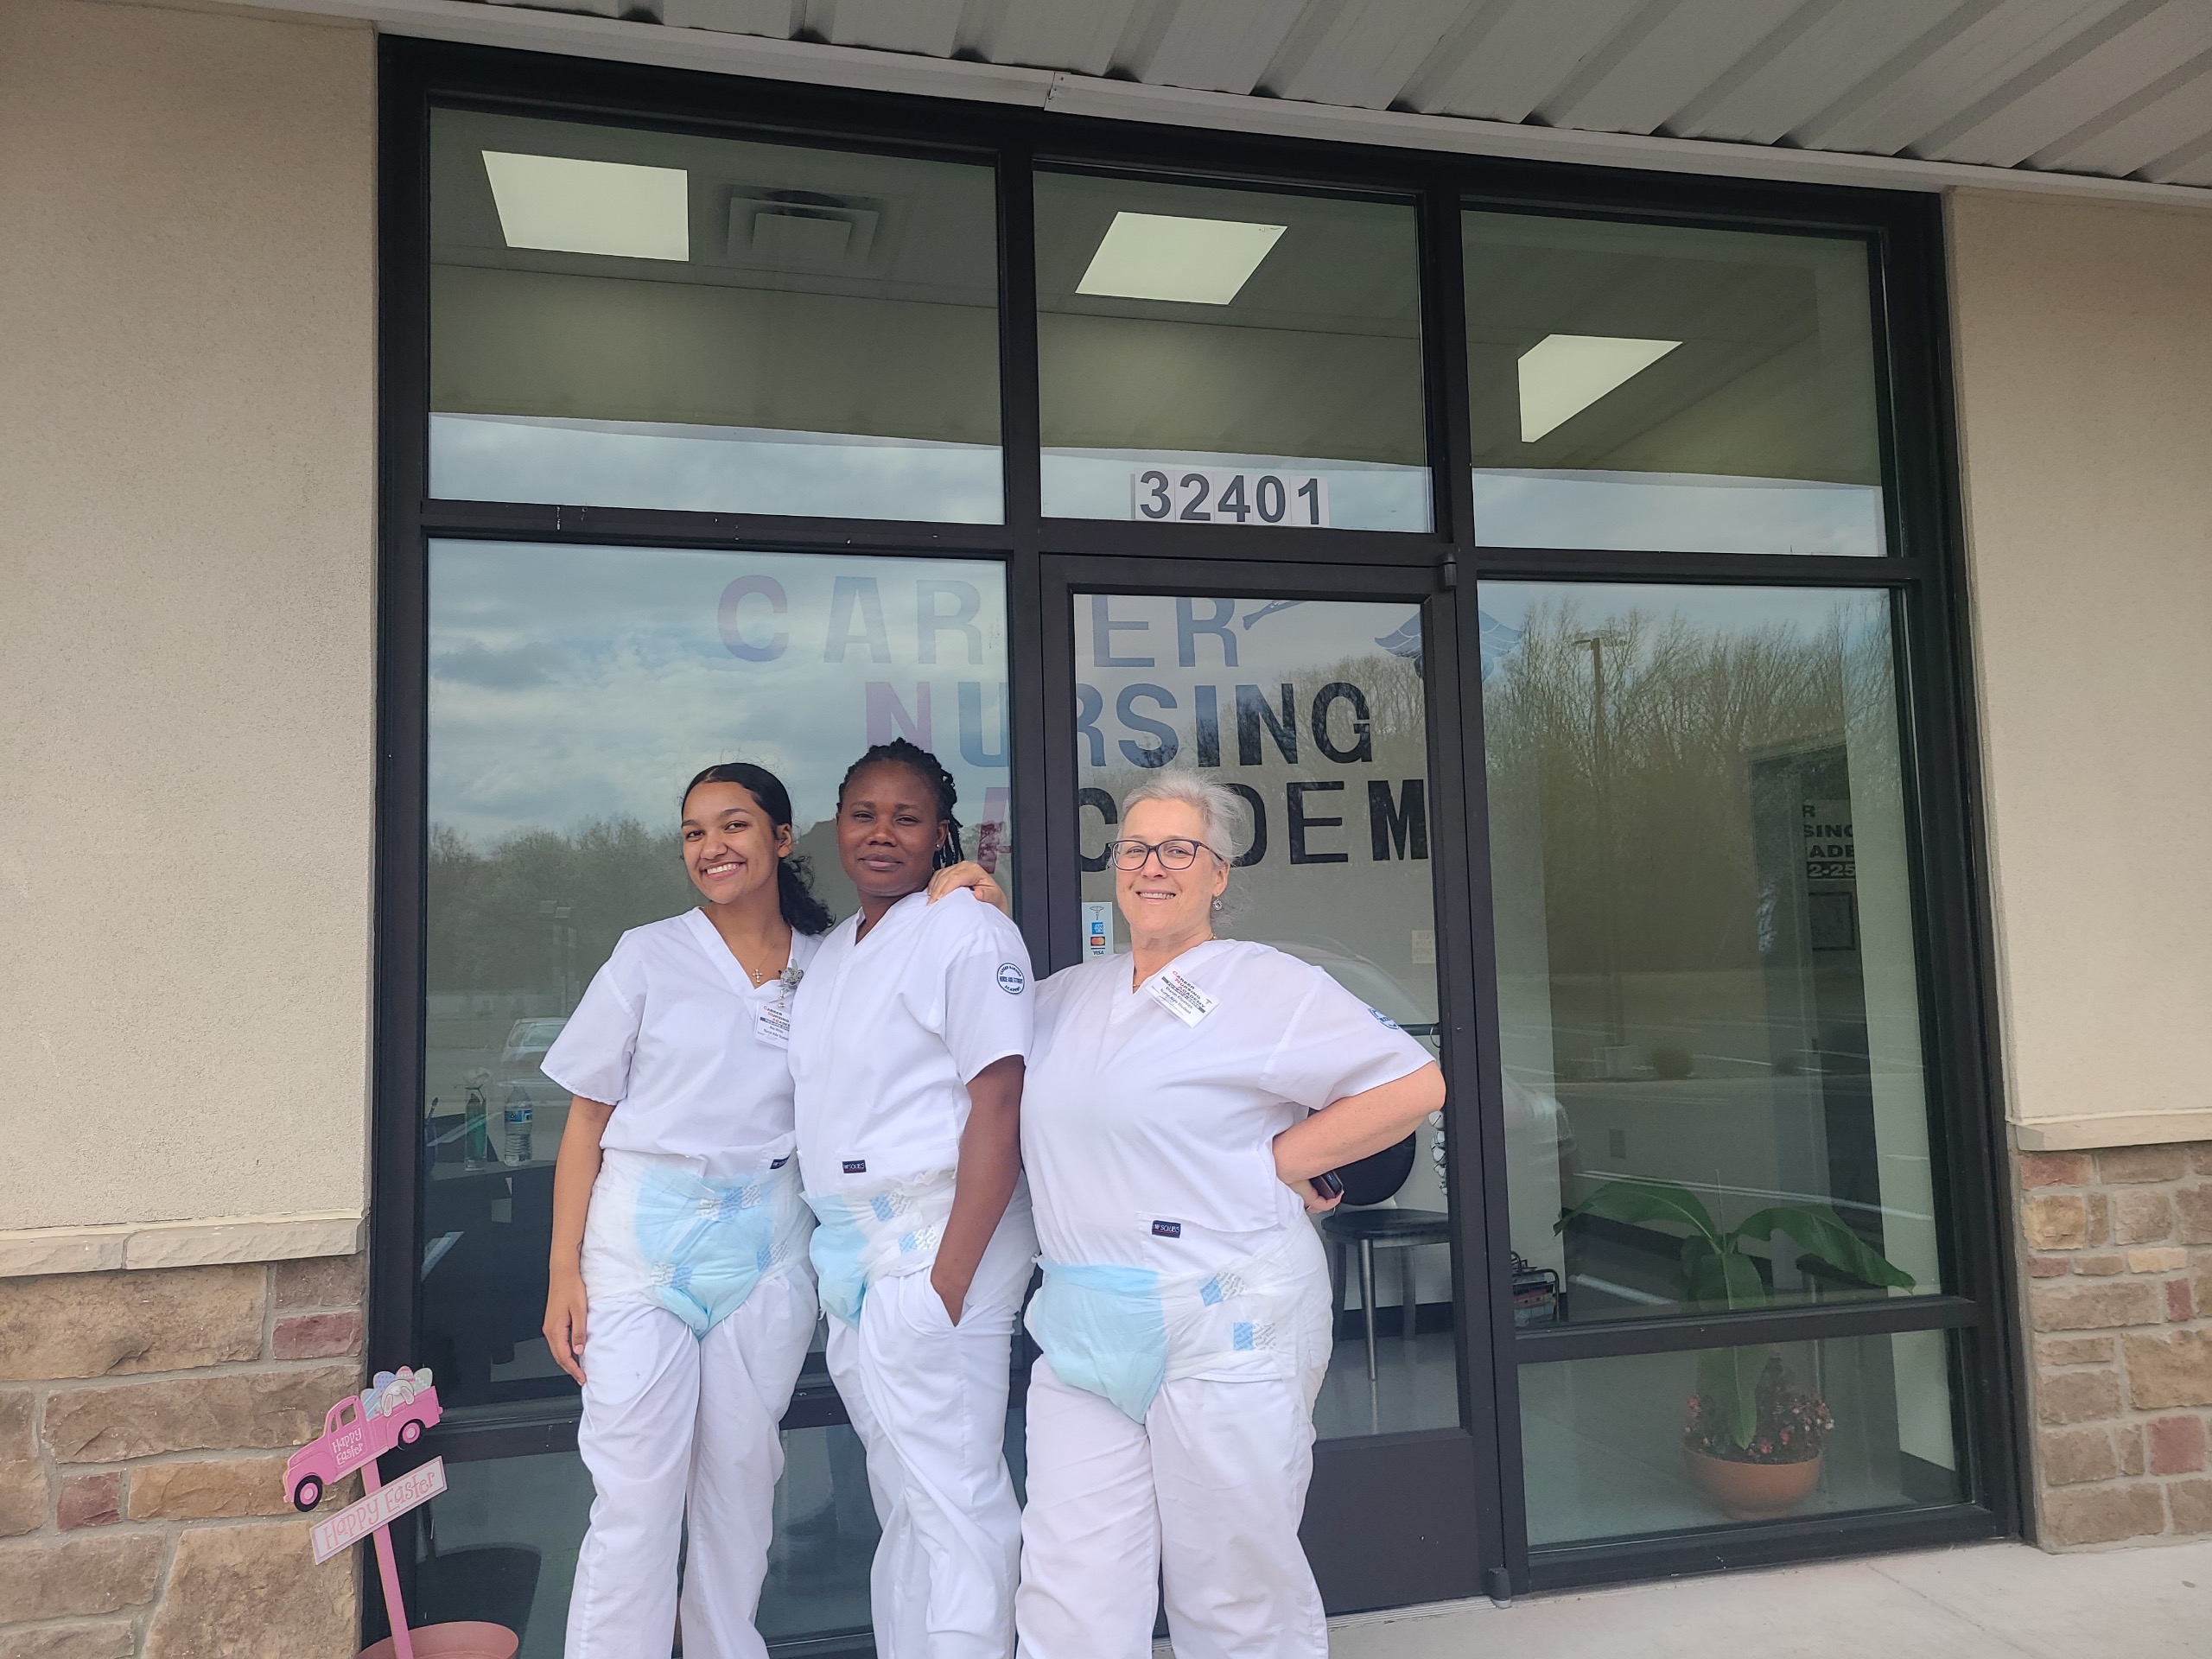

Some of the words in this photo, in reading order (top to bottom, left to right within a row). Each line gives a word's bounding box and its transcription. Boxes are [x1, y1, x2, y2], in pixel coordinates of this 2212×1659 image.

[1140, 470, 1322, 524] 32401
[717, 575, 1239, 667] CARER
[331, 1428, 363, 1453] Happy
[336, 1442, 364, 1465] Easter
[323, 1498, 379, 1551] Happy
[385, 1471, 435, 1510] Easter
